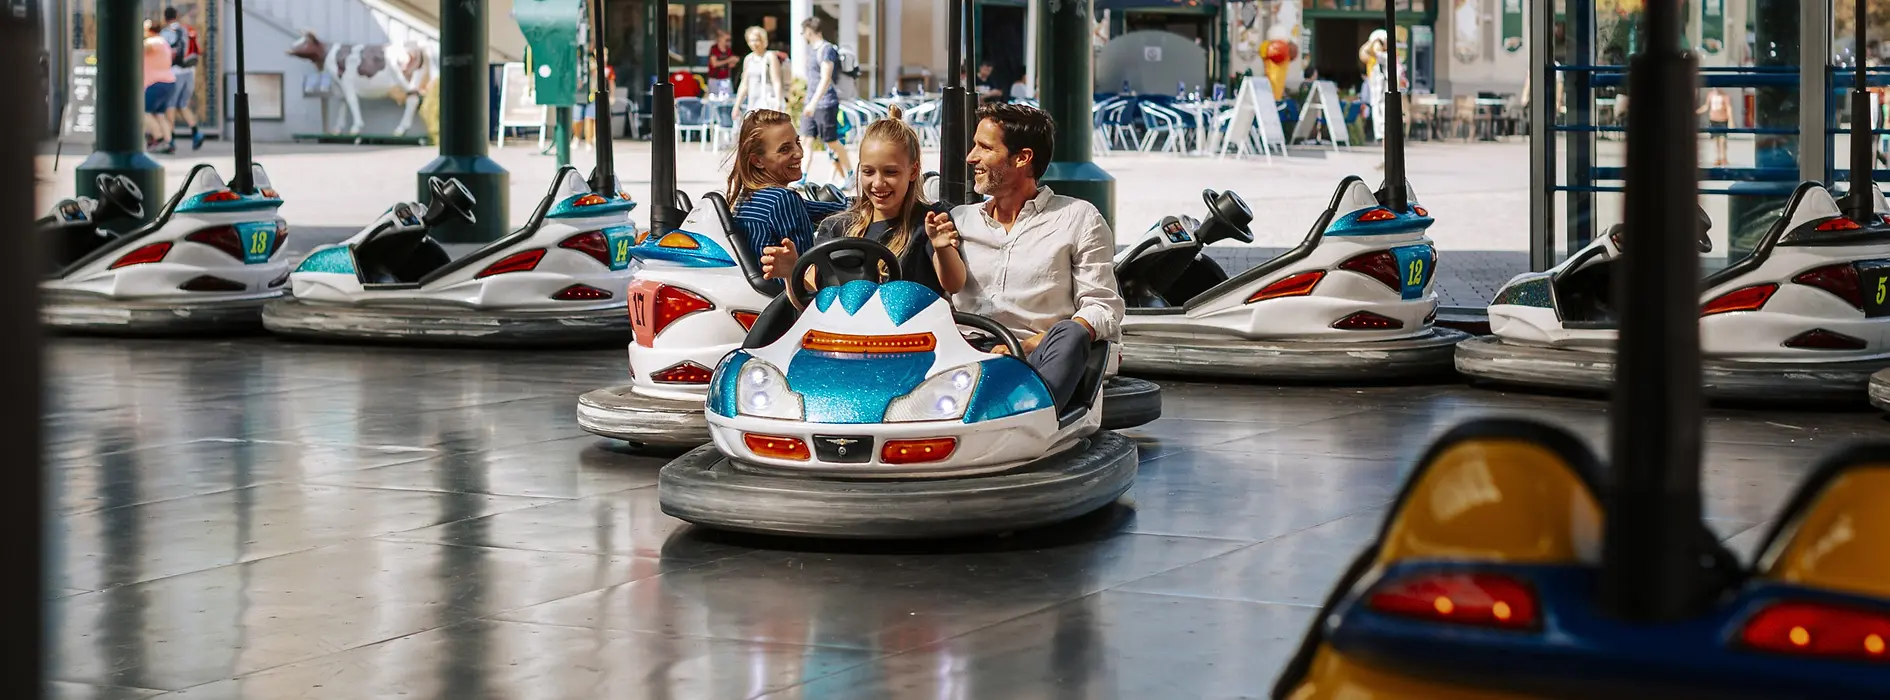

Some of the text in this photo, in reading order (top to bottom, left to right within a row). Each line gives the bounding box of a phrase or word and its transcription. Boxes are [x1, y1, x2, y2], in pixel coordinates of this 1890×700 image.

[250, 231, 267, 254] 13
[615, 239, 628, 262] 14
[1407, 259, 1423, 285] 12
[1876, 276, 1888, 305] 5
[633, 292, 646, 327] 17
